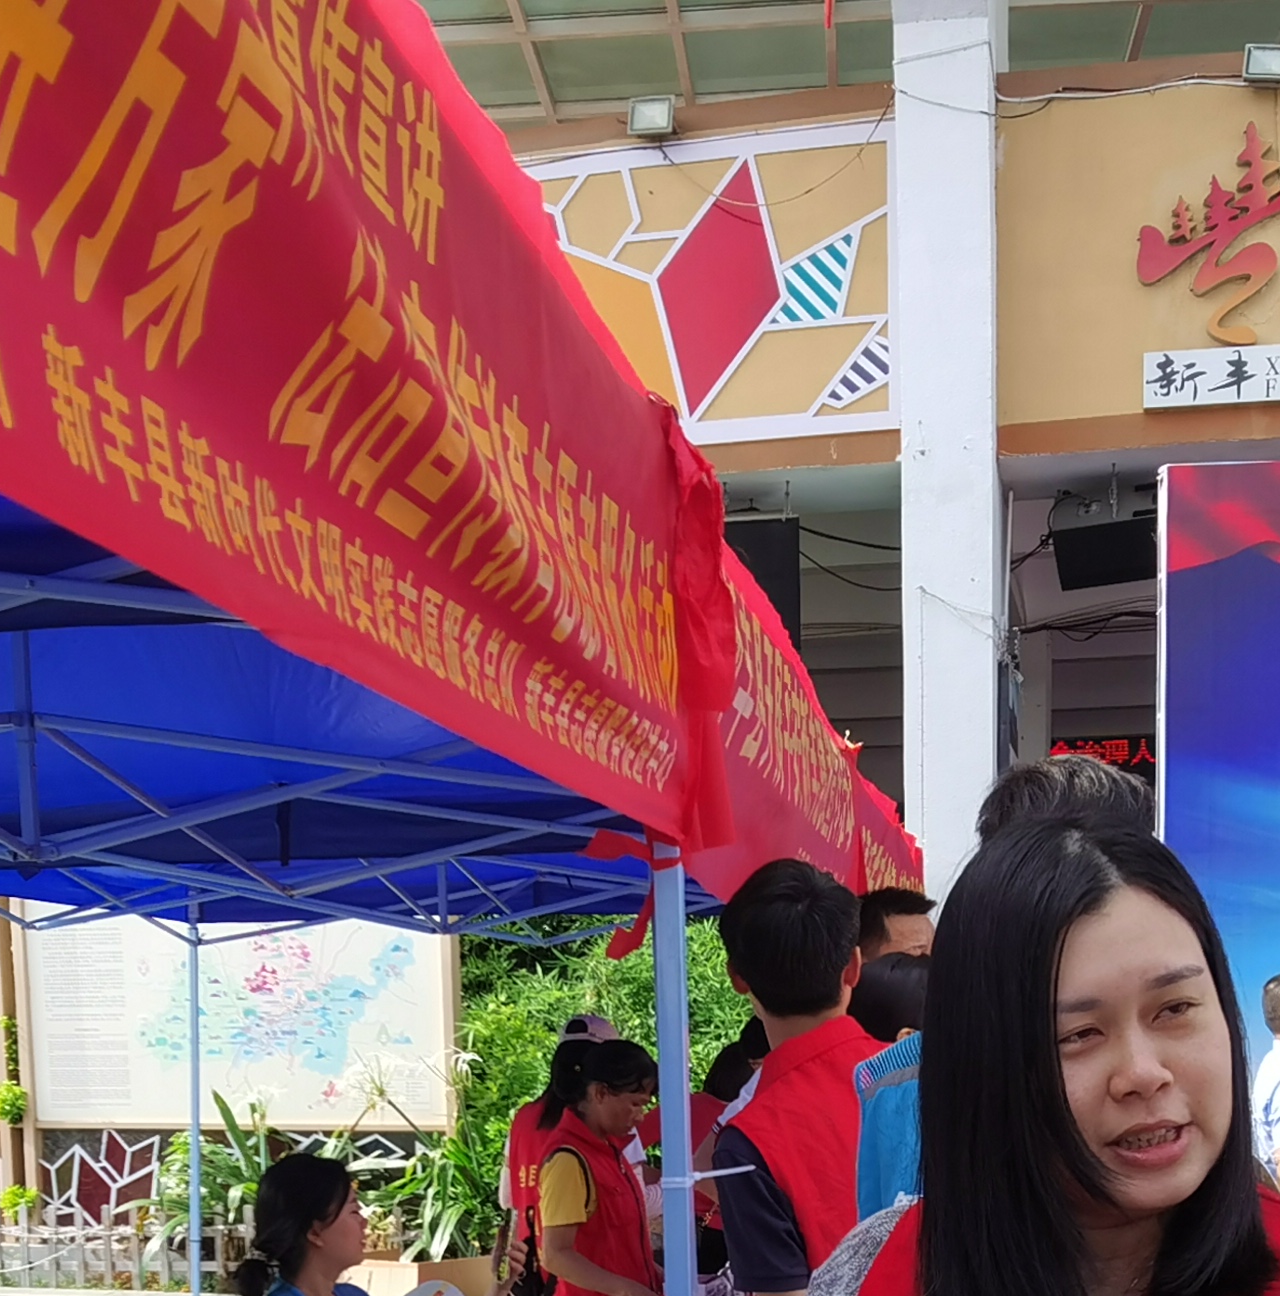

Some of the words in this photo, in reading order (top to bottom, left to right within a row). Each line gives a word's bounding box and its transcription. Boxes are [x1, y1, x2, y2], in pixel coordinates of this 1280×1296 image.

[1145, 350, 1259, 402] 新丰
[40, 322, 527, 722] 新丰县新时代文明实践志愿服务总队
